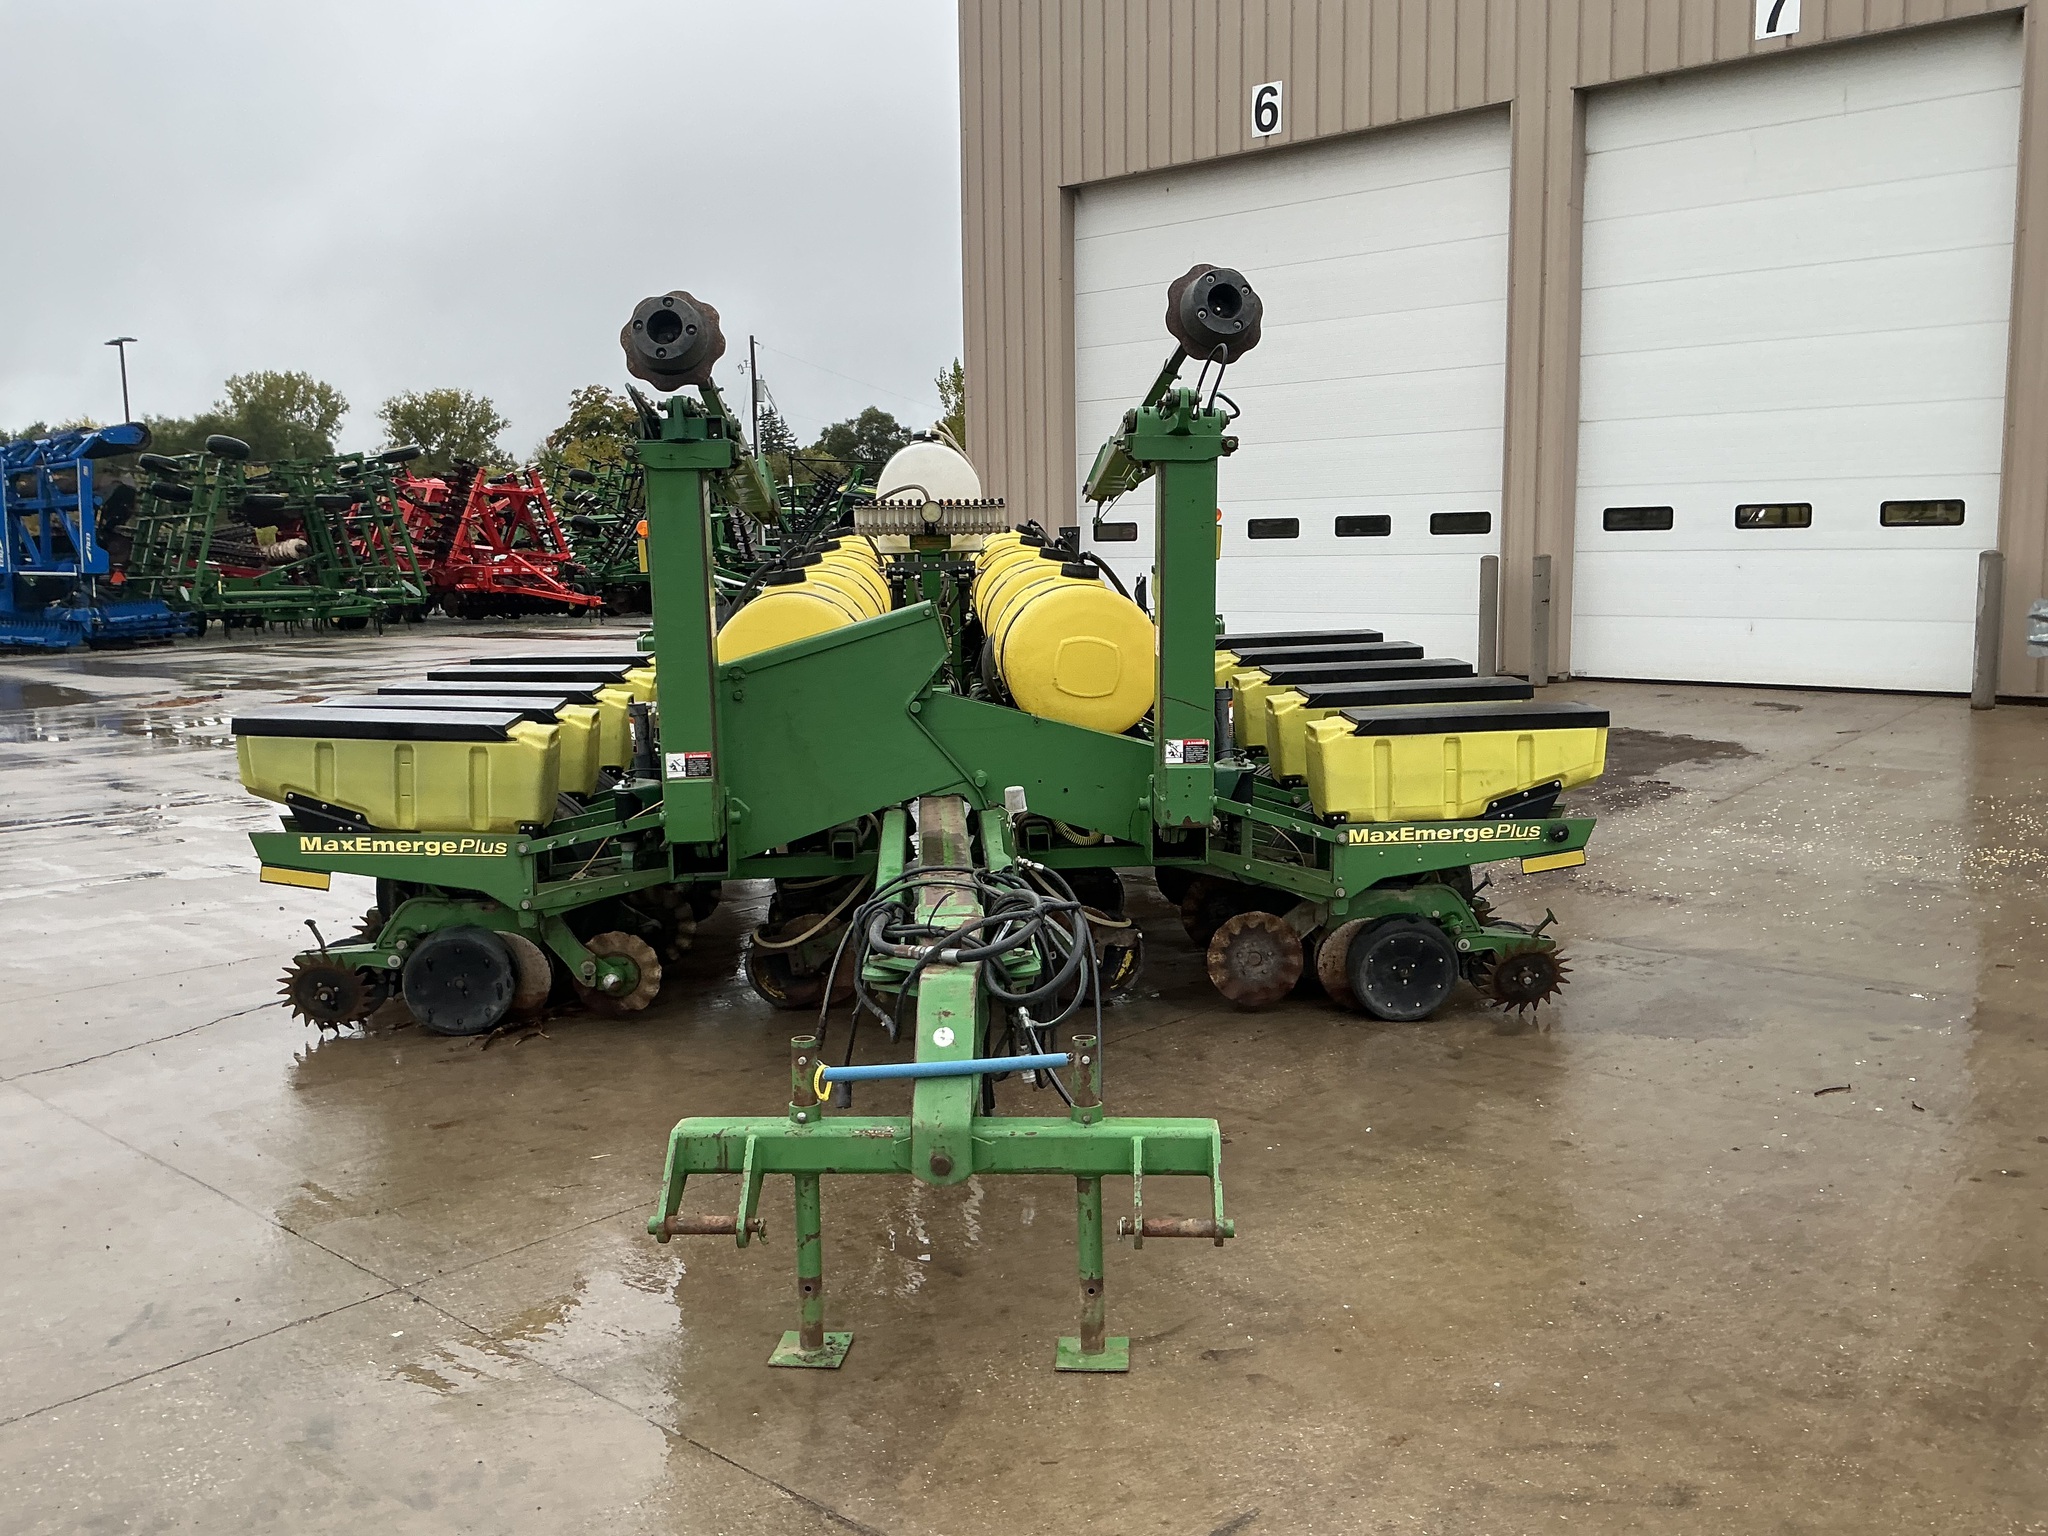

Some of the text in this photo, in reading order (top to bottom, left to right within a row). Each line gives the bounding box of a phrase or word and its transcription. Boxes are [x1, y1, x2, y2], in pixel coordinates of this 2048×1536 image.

[1255, 86, 1278, 132] 6
[300, 836, 508, 856] MaxEmergePlus
[1349, 824, 1541, 846] MaxEmergePlus
